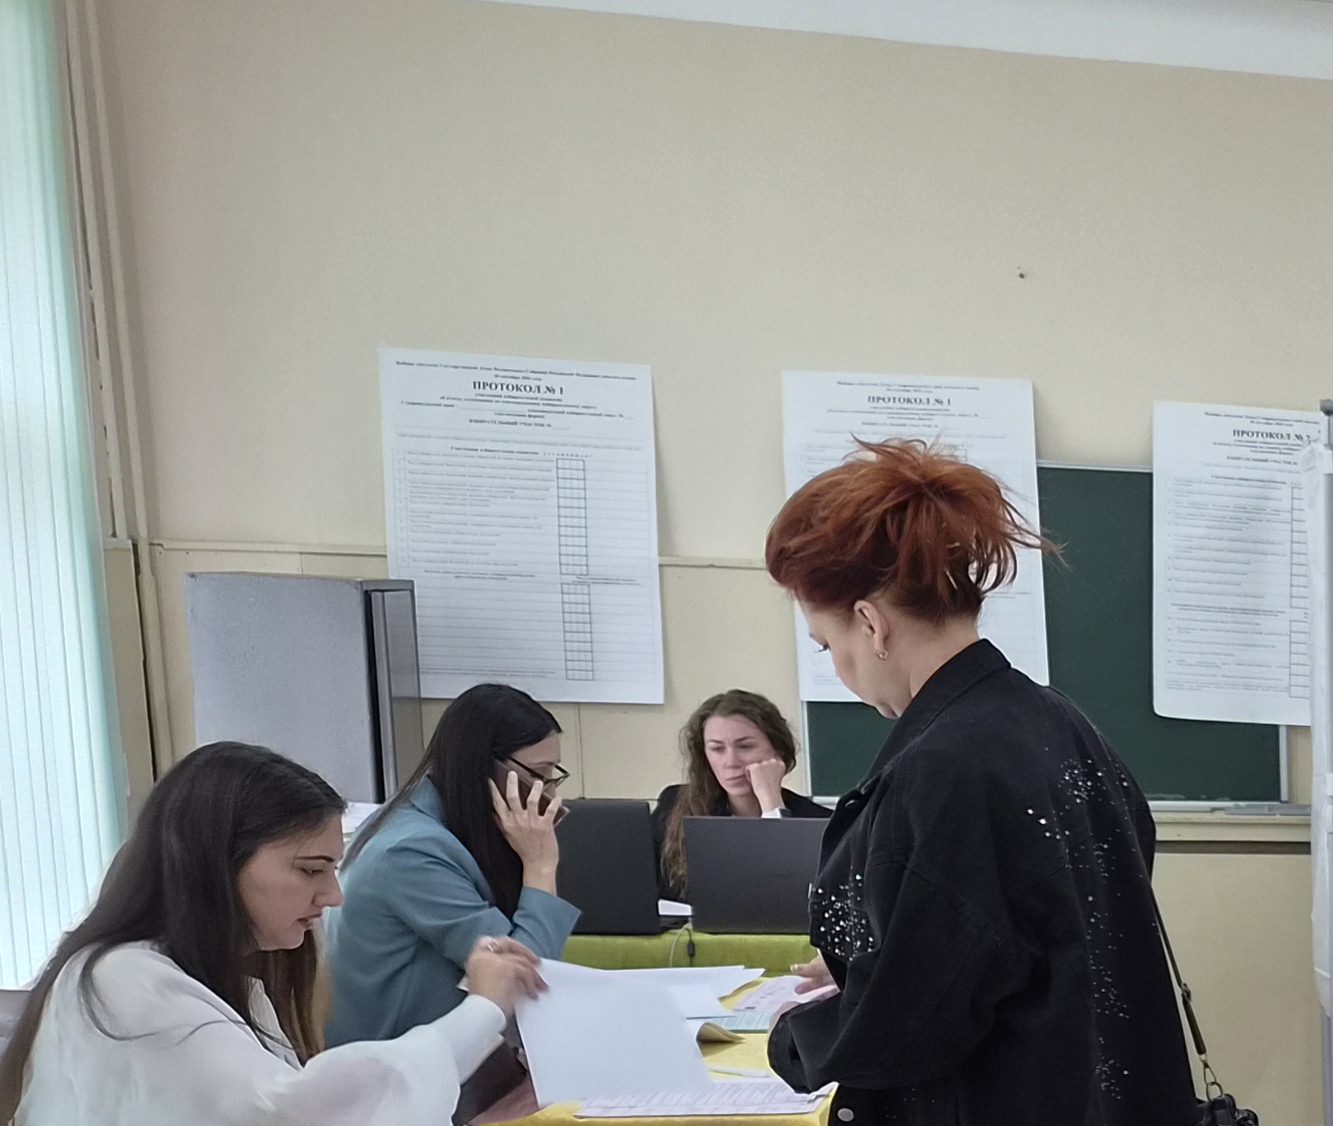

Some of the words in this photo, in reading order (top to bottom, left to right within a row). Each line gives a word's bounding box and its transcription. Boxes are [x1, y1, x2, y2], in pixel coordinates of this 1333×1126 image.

[472, 380, 541, 395] ПРОТОКОЛ
[867, 395, 931, 406] ПРОТОКОЛ
[1232, 428, 1291, 442] ПРОТОКОЛ
